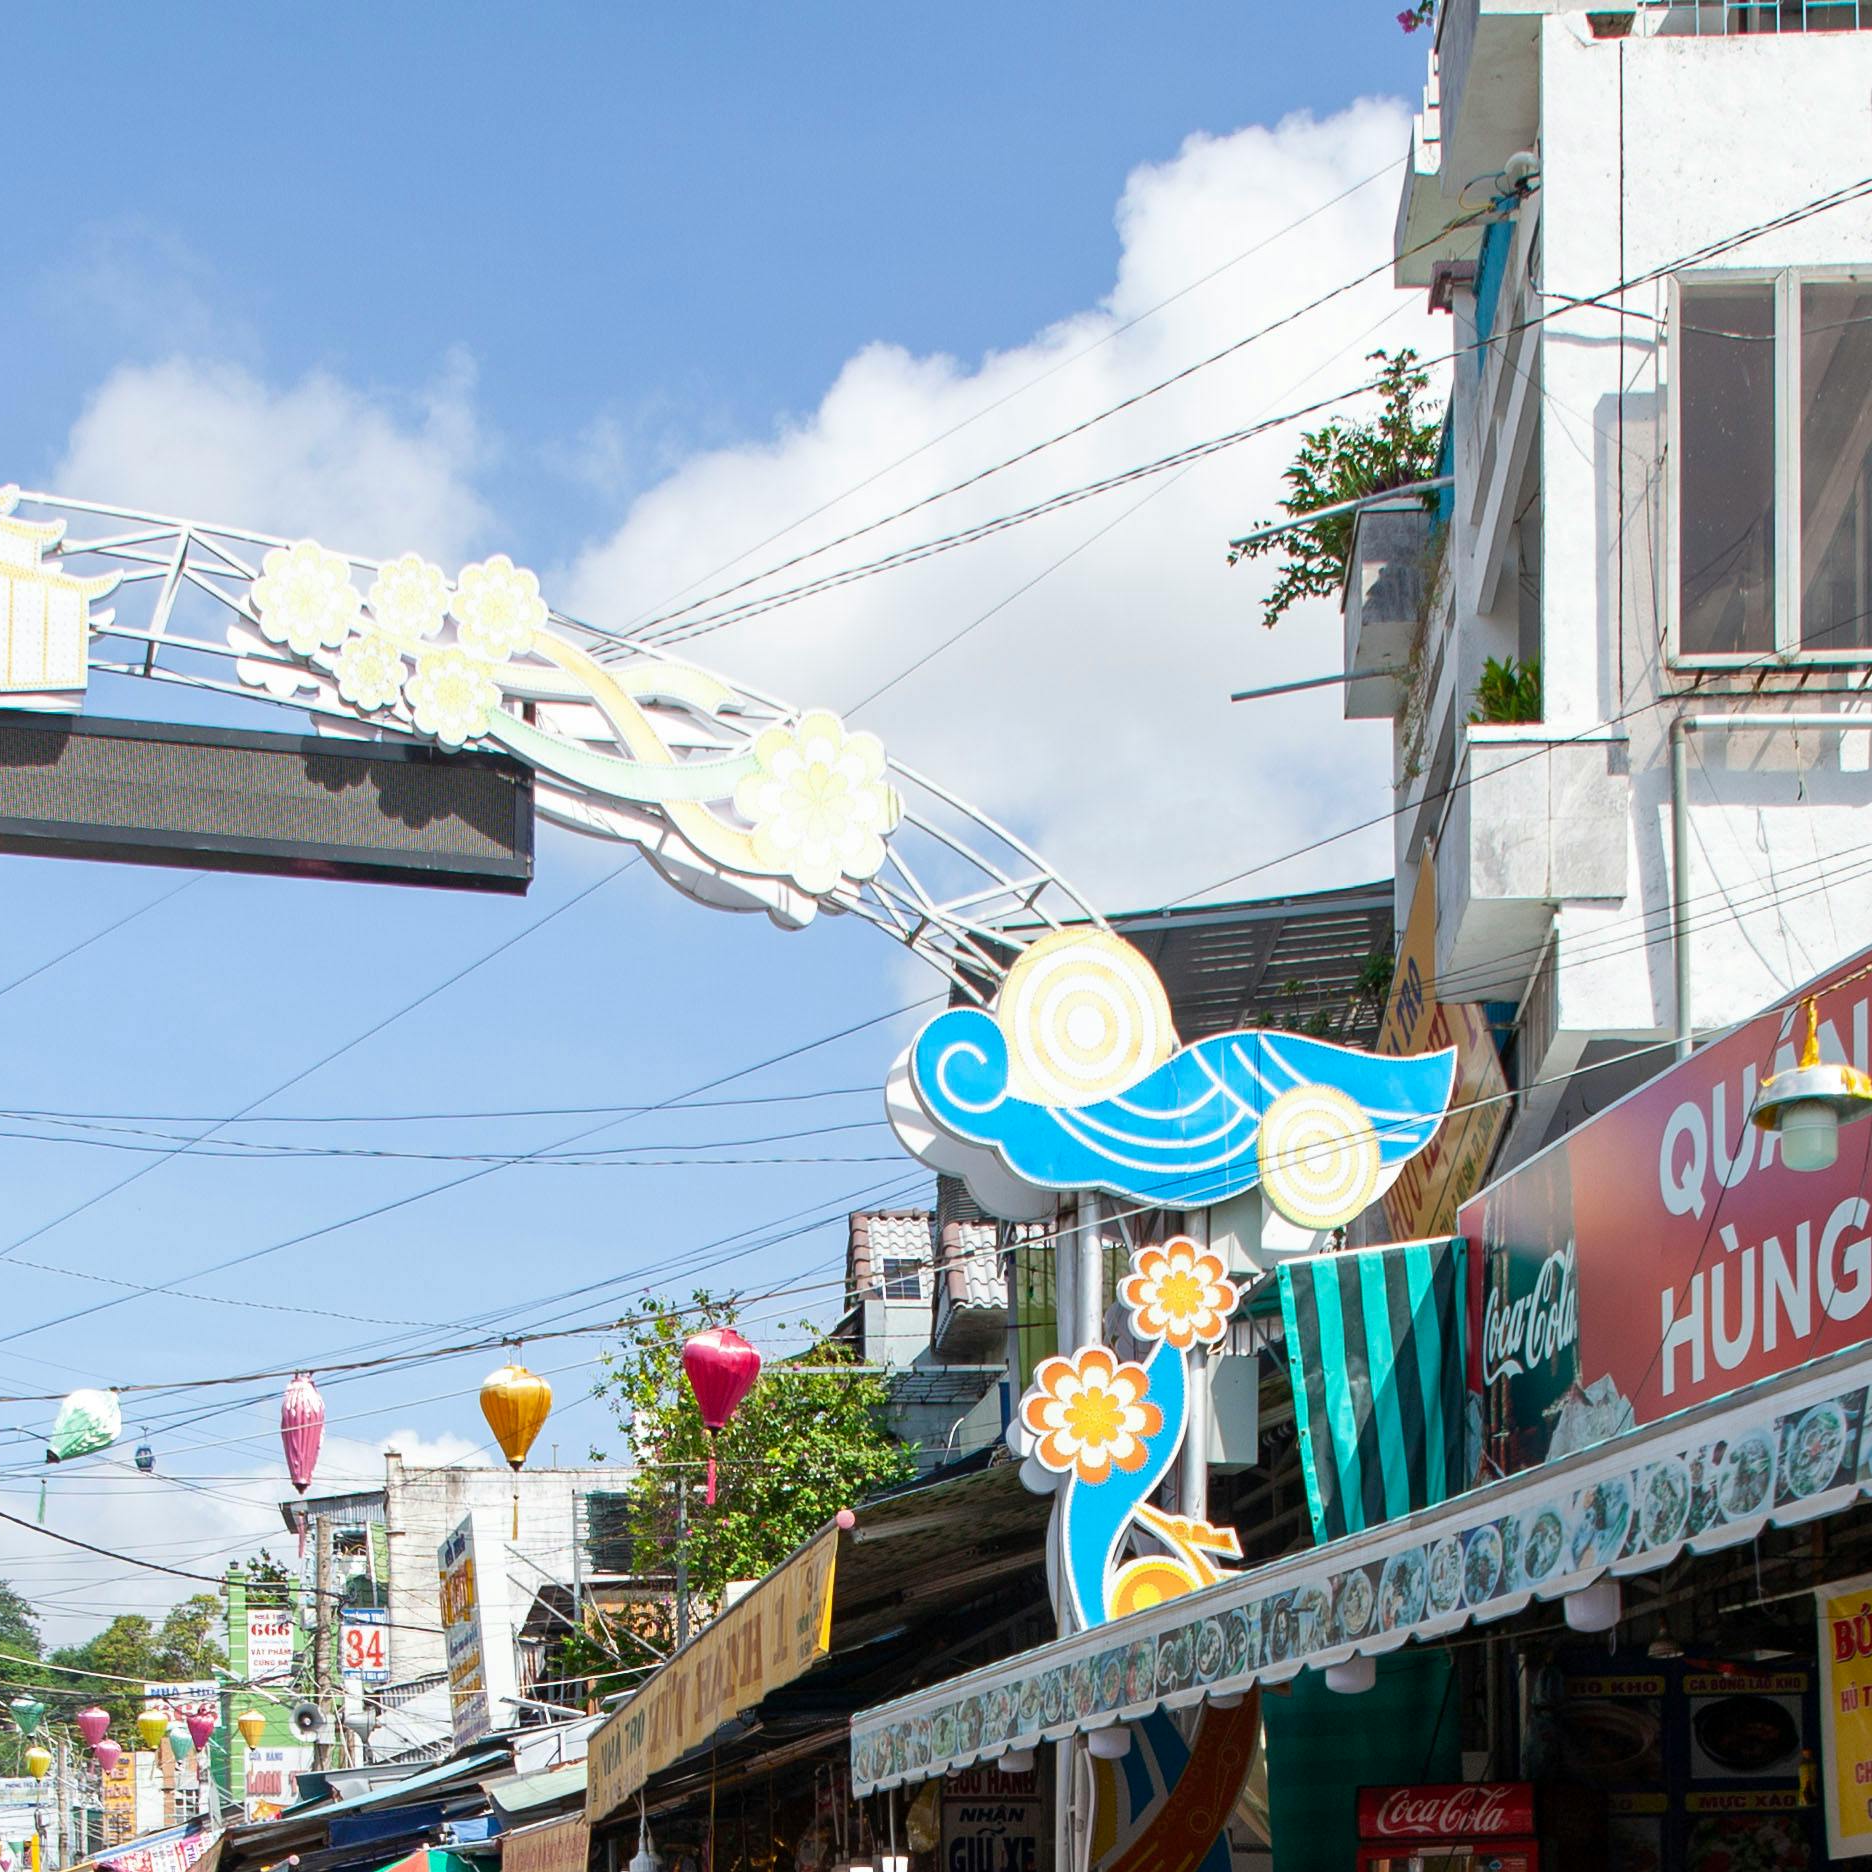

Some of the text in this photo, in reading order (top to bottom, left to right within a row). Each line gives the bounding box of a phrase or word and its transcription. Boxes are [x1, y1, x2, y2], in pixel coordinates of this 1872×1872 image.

[1482, 1239, 1577, 1387] Coca-Cola
[1661, 1196, 1872, 1397] HÙNG
[346, 1629, 385, 1669] 34
[1841, 1681, 1859, 1713] HỦ
[959, 1803, 1026, 1824] NHẬN
[1378, 1785, 1514, 1835] Coca-Cola
